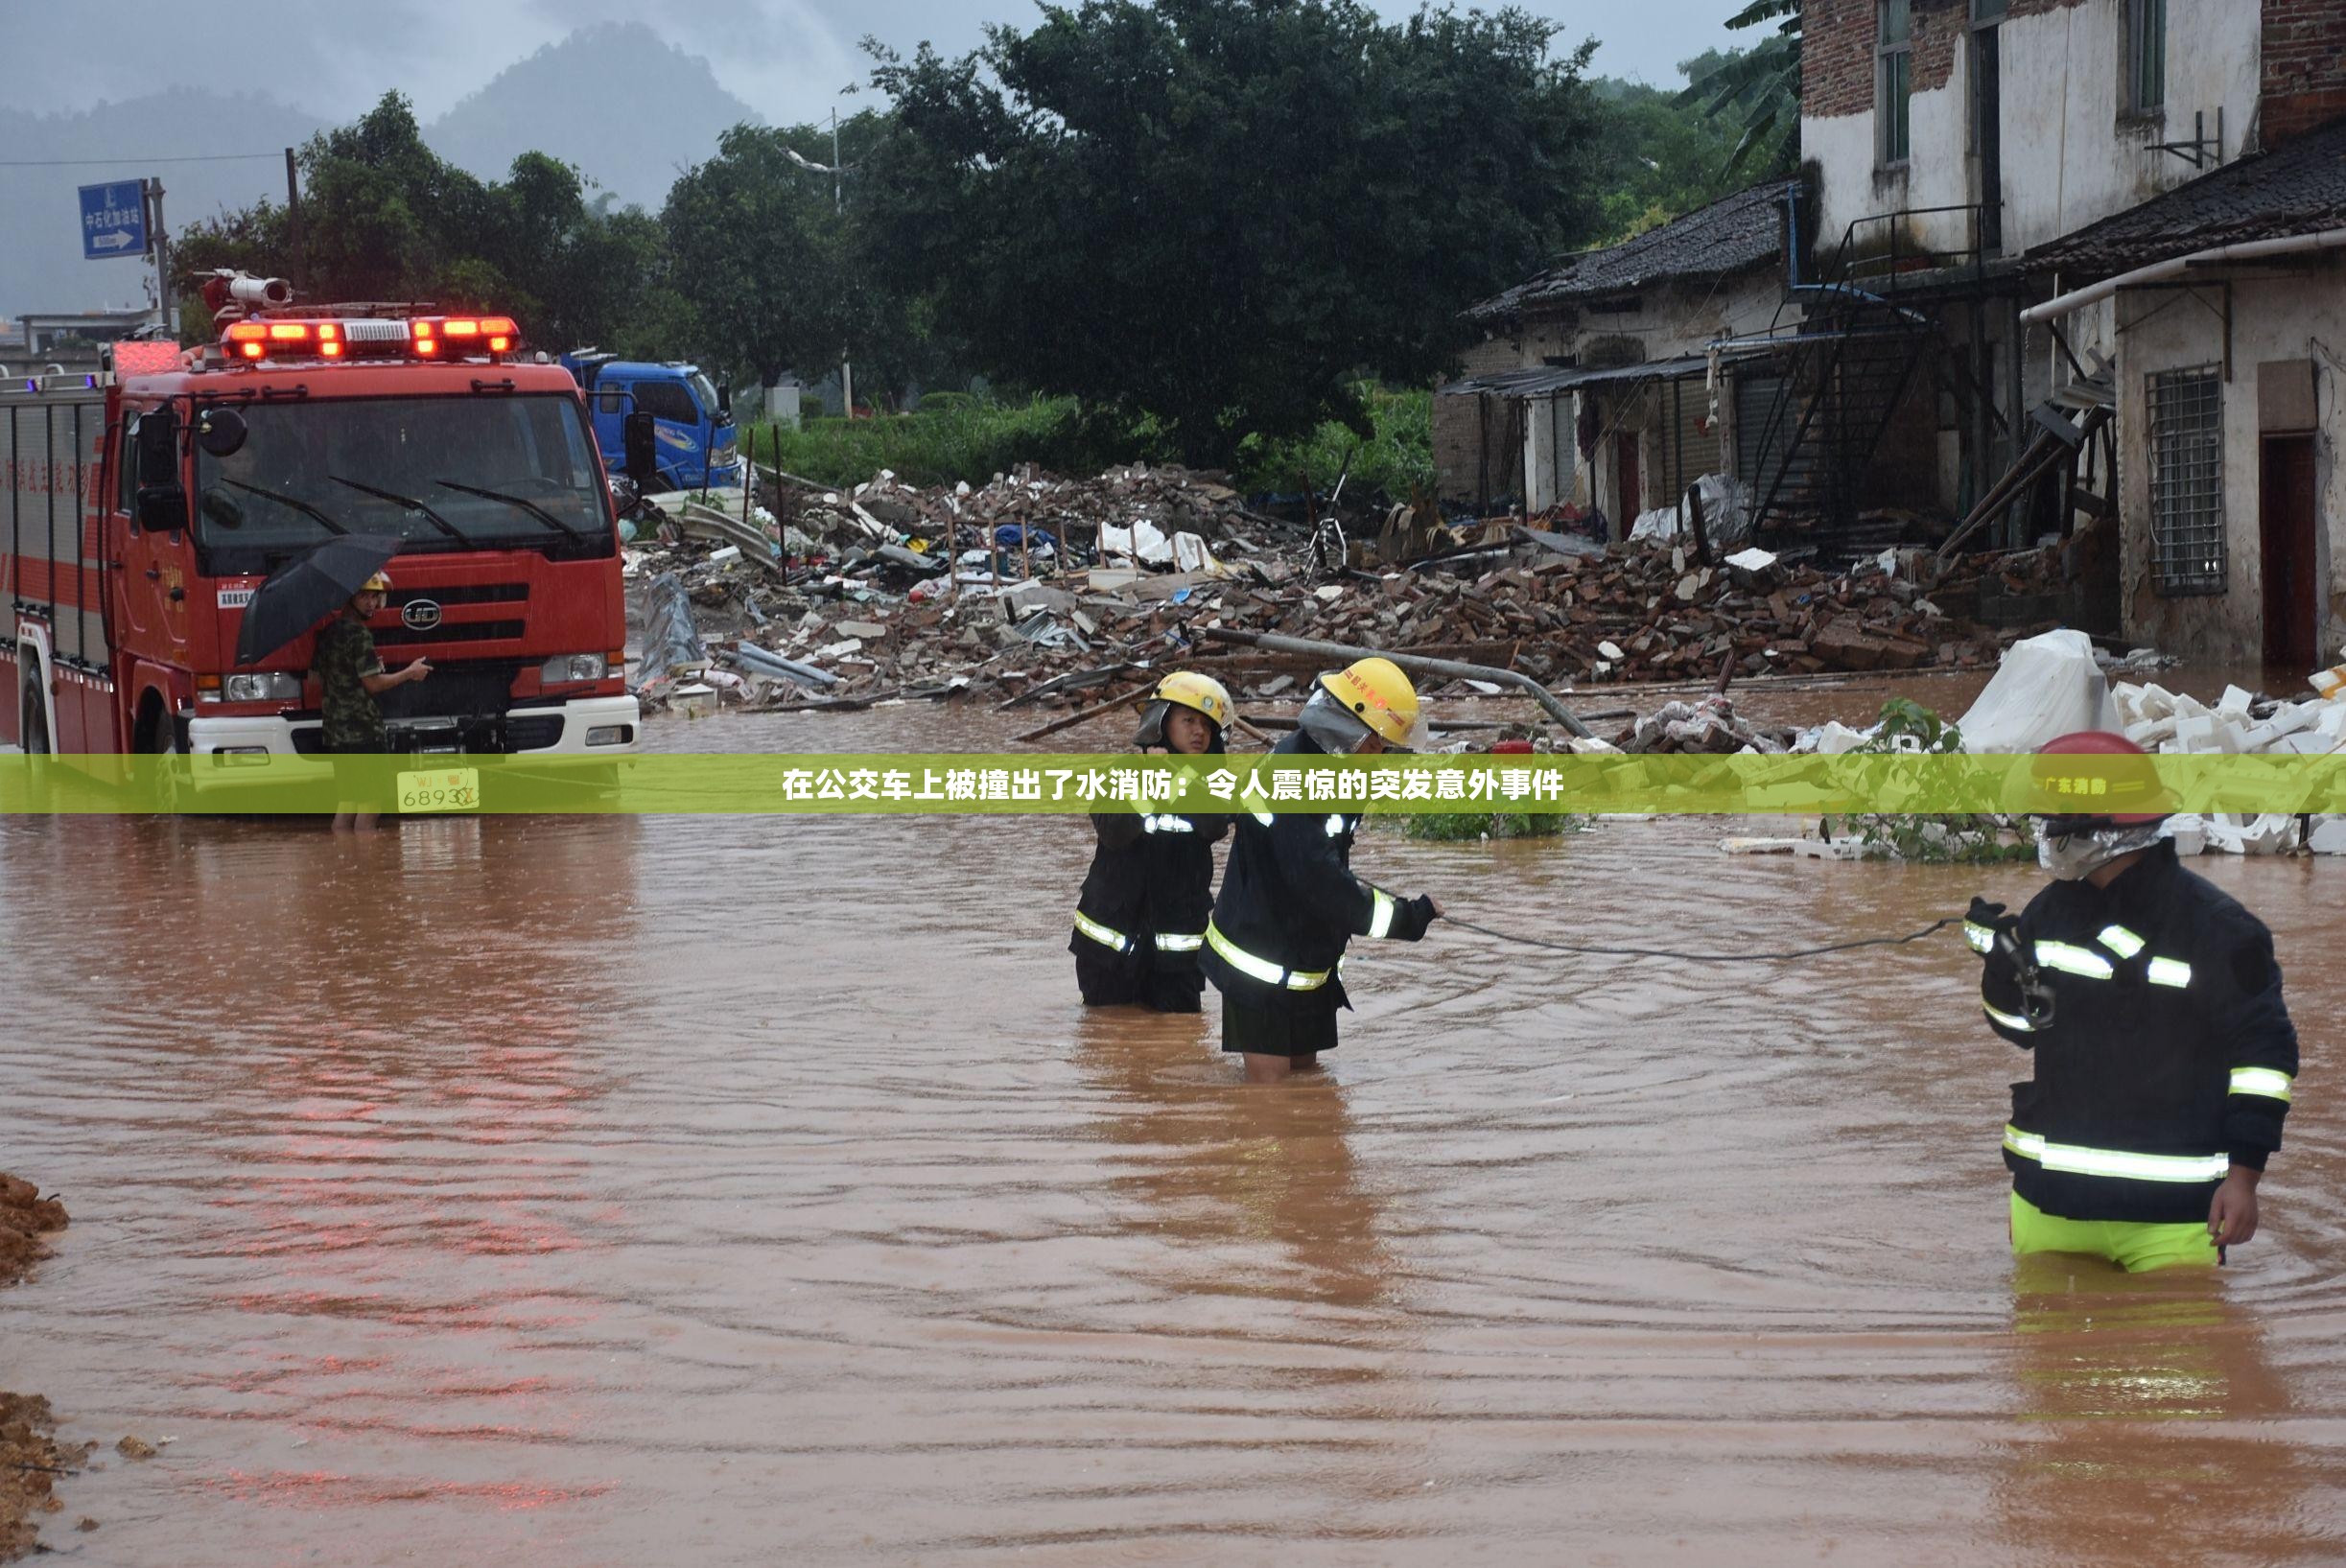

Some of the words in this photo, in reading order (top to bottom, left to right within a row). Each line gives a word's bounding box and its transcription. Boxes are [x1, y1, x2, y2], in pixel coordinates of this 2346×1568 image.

[85, 206, 140, 230] 中石化加油站
[2045, 777, 2106, 795] 广东消防
